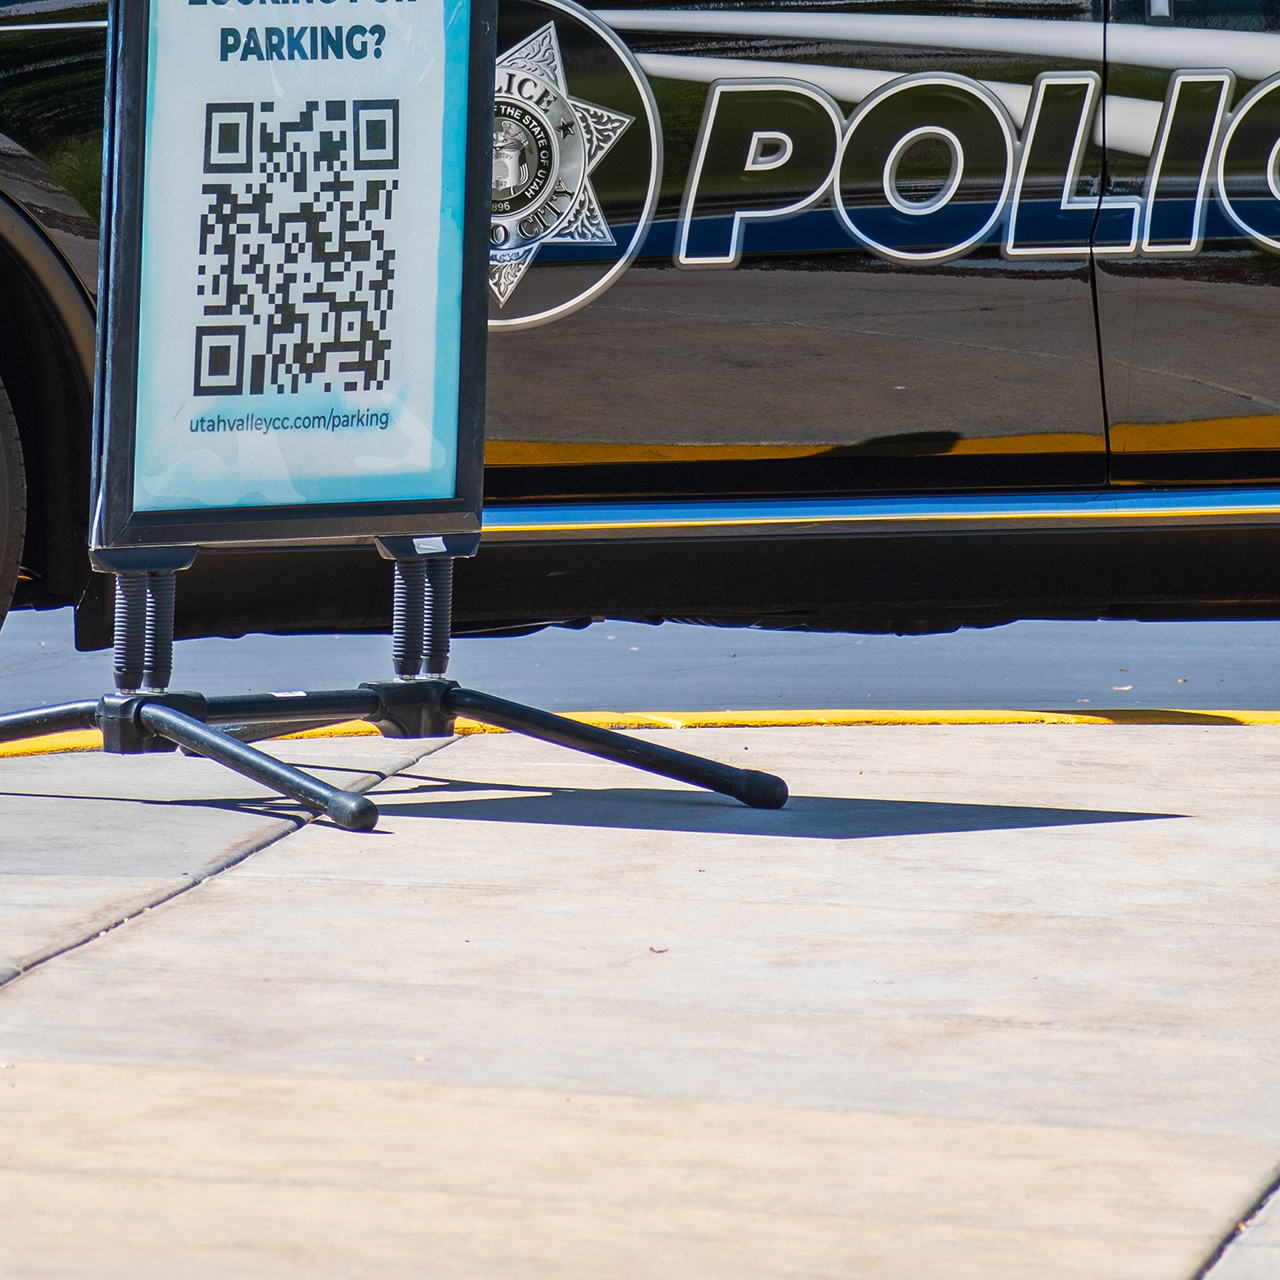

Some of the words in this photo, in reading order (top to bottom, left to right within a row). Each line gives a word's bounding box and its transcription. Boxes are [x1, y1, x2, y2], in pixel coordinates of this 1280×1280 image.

[220, 24, 386, 61] PARKING?
[499, 104, 523, 119] THE
[522, 113, 547, 147] STATE
[539, 150, 550, 167] OF
[524, 169, 547, 199] UTAH
[491, 201, 511, 212] 896
[517, 178, 574, 239] CITY
[189, 408, 389, 434] utahvalleycc.com/parking
